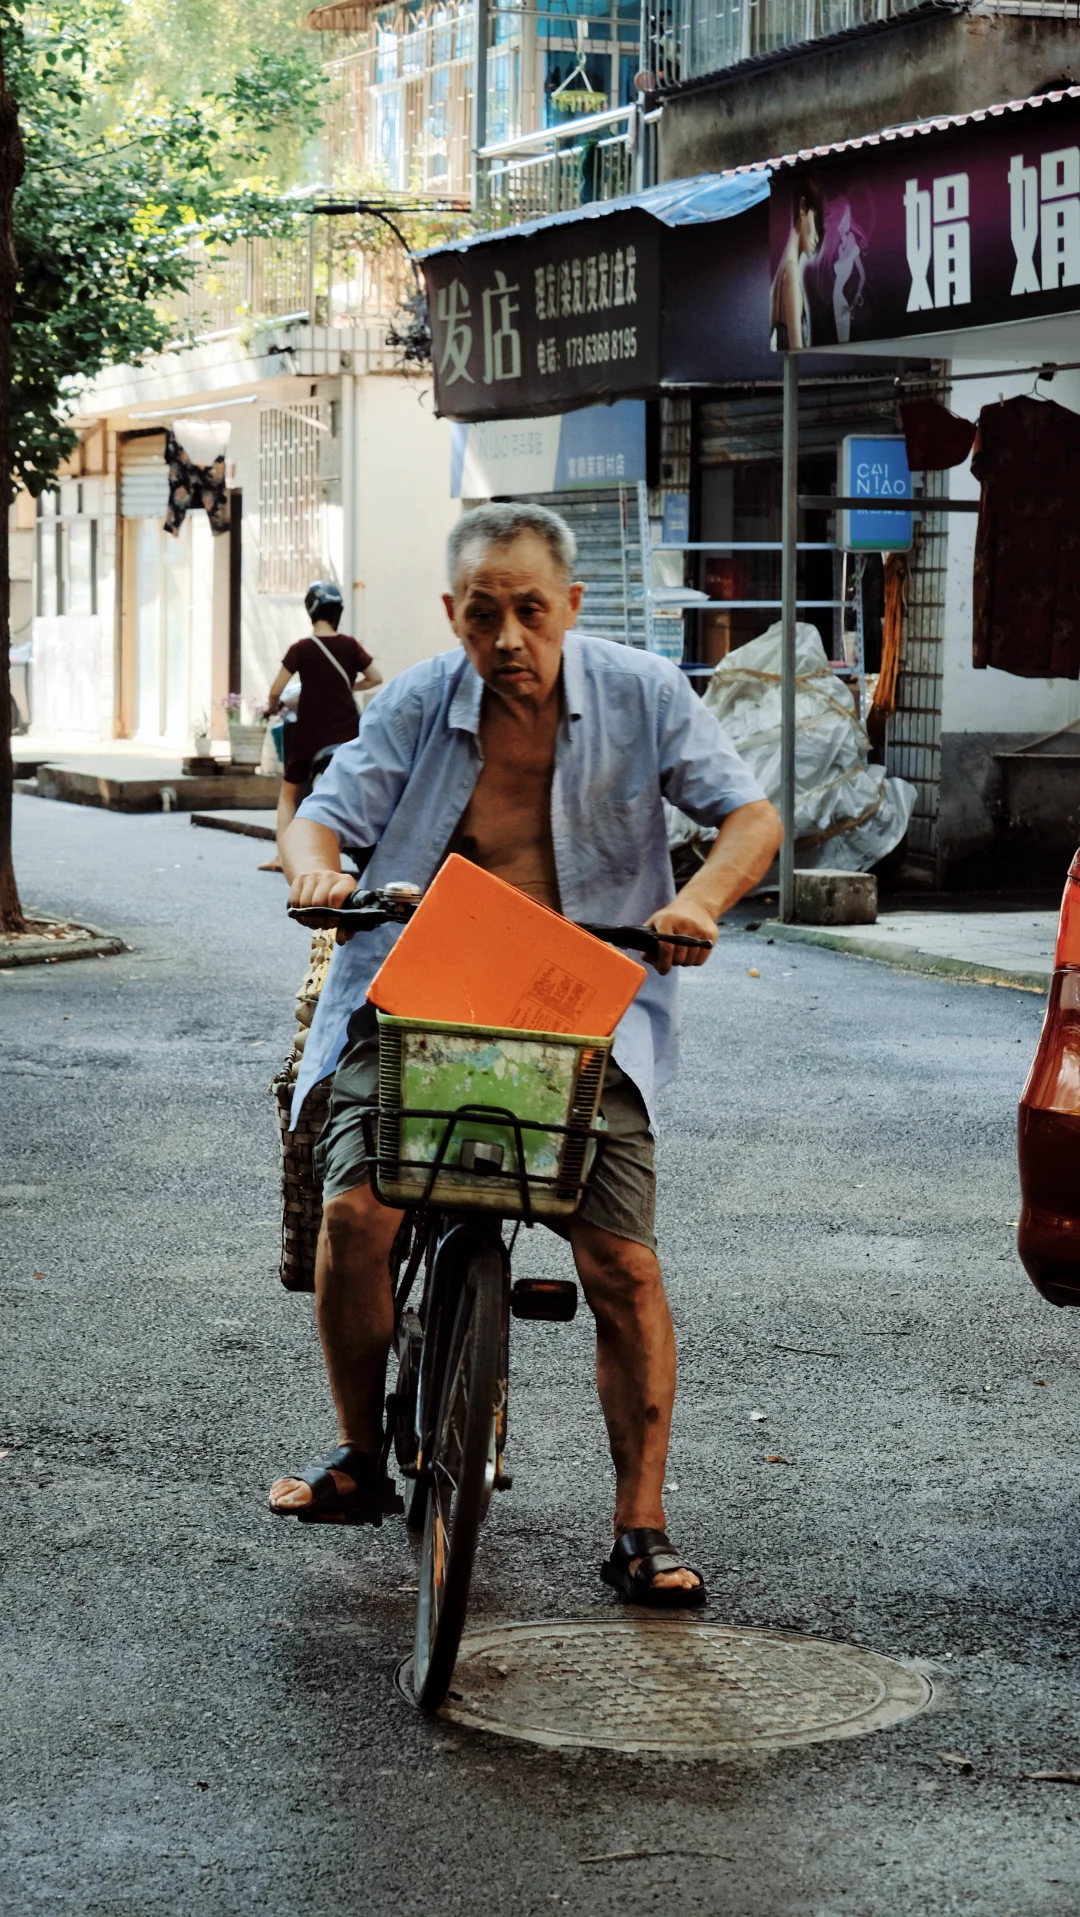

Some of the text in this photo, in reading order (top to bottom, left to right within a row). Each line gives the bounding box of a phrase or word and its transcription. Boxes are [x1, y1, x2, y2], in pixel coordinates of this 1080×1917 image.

[903, 146, 1080, 312] 娟娟
[437, 270, 521, 386] 发店
[857, 463, 888, 478] CAI
